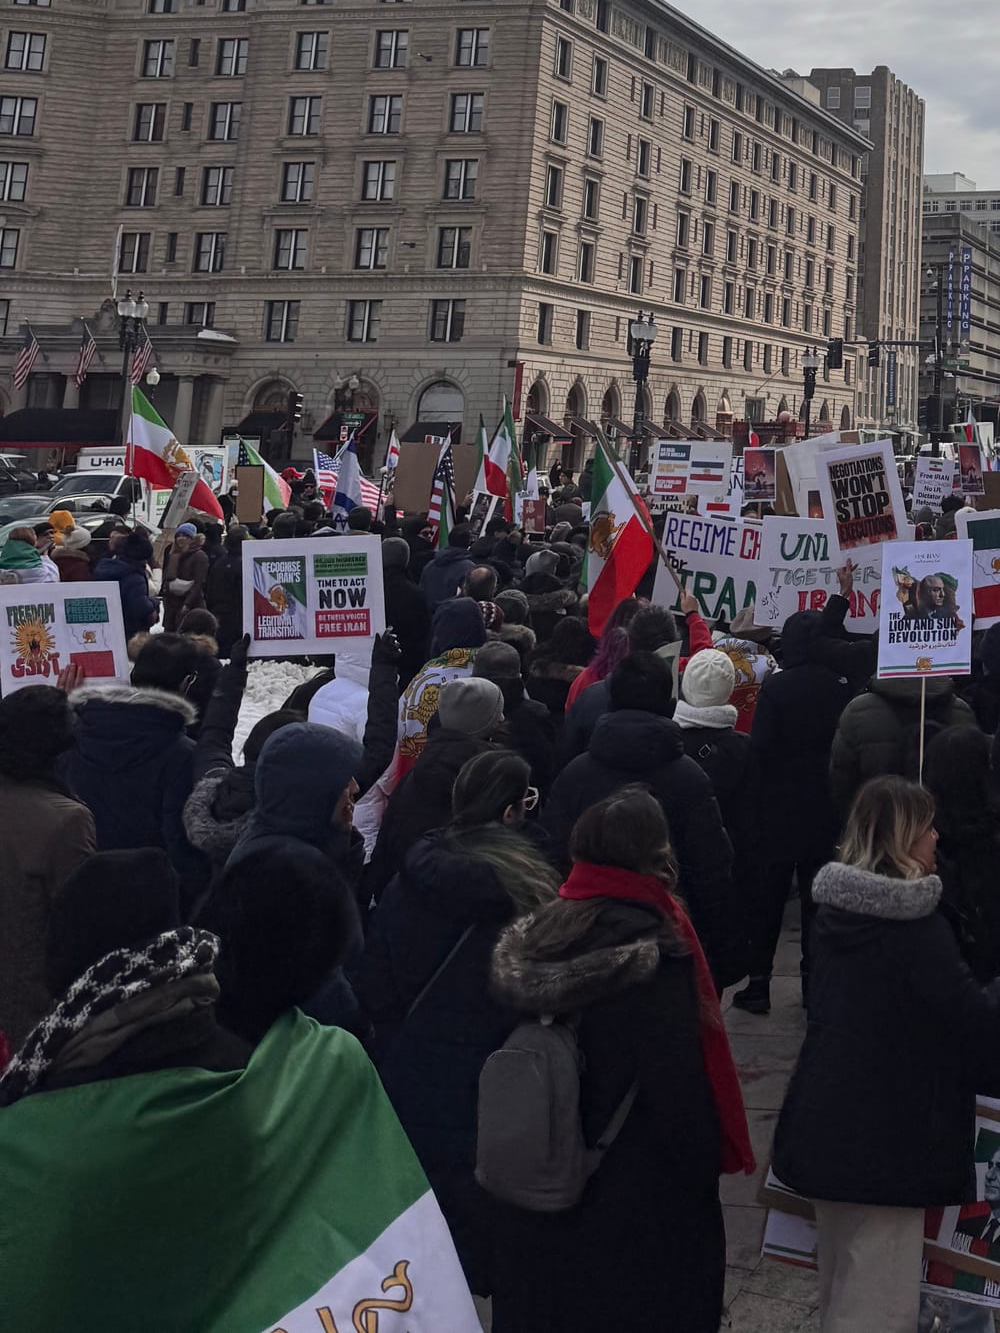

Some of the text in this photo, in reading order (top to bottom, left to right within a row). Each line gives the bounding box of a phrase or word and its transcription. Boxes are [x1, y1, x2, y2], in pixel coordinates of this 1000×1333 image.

[962, 266, 970, 328] PARKING
[829, 456, 884, 480] NEGOTIATIONS
[831, 471, 886, 499] WON'T
[836, 492, 890, 522] STOP
[665, 518, 738, 556] REGIME
[839, 514, 894, 543] EXECUTIONS
[262, 561, 301, 572] RECOGNISE
[666, 550, 688, 570] For
[276, 572, 301, 584] IRAN'S
[318, 578, 366, 588] TIME TO ACT
[770, 566, 881, 587] TOGETER
[318, 587, 366, 610] NOW
[889, 612, 900, 620] THE
[889, 618, 957, 632] LION AND SUN
[320, 622, 366, 633] FREE IRAN
[889, 629, 957, 644] REVOLUTION
